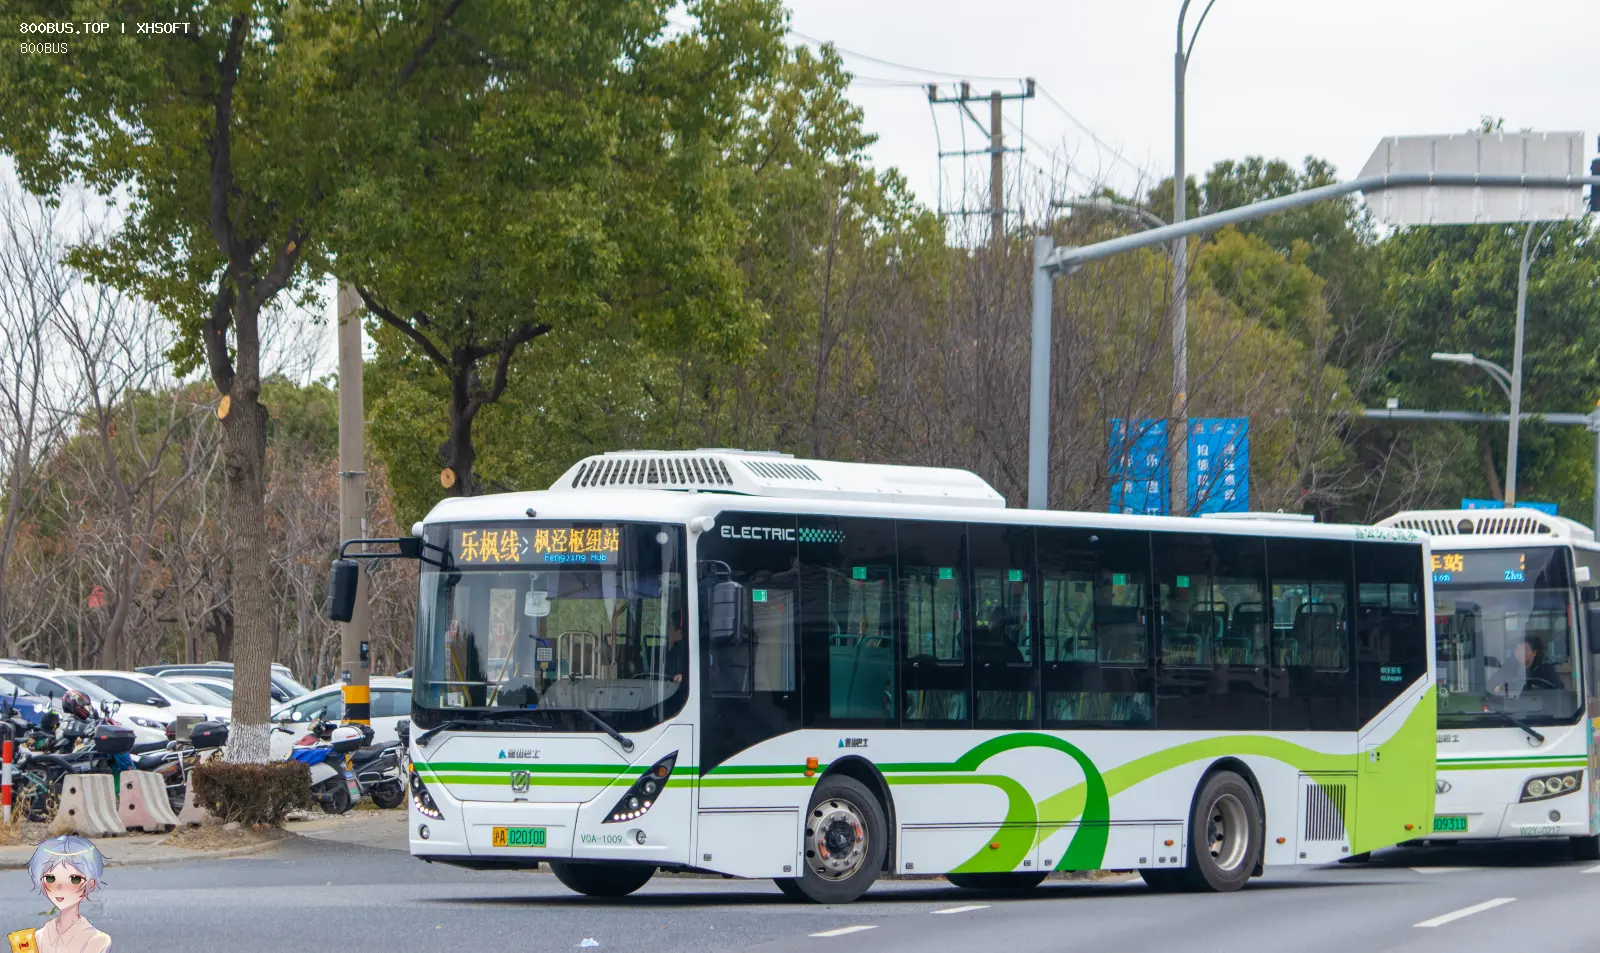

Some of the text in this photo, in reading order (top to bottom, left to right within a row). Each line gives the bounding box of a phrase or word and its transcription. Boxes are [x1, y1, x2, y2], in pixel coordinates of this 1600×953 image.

[721, 525, 796, 541] ELECTRIC
[460, 528, 620, 562] 乐枫线 枫泾枢纽站
[543, 552, 607, 562] Fengjing Hub
[1431, 553, 1464, 572] 车站
[1433, 572, 1451, 582] ion
[1504, 569, 1525, 581] Zhu
[1436, 734, 1460, 743] 山巴士
